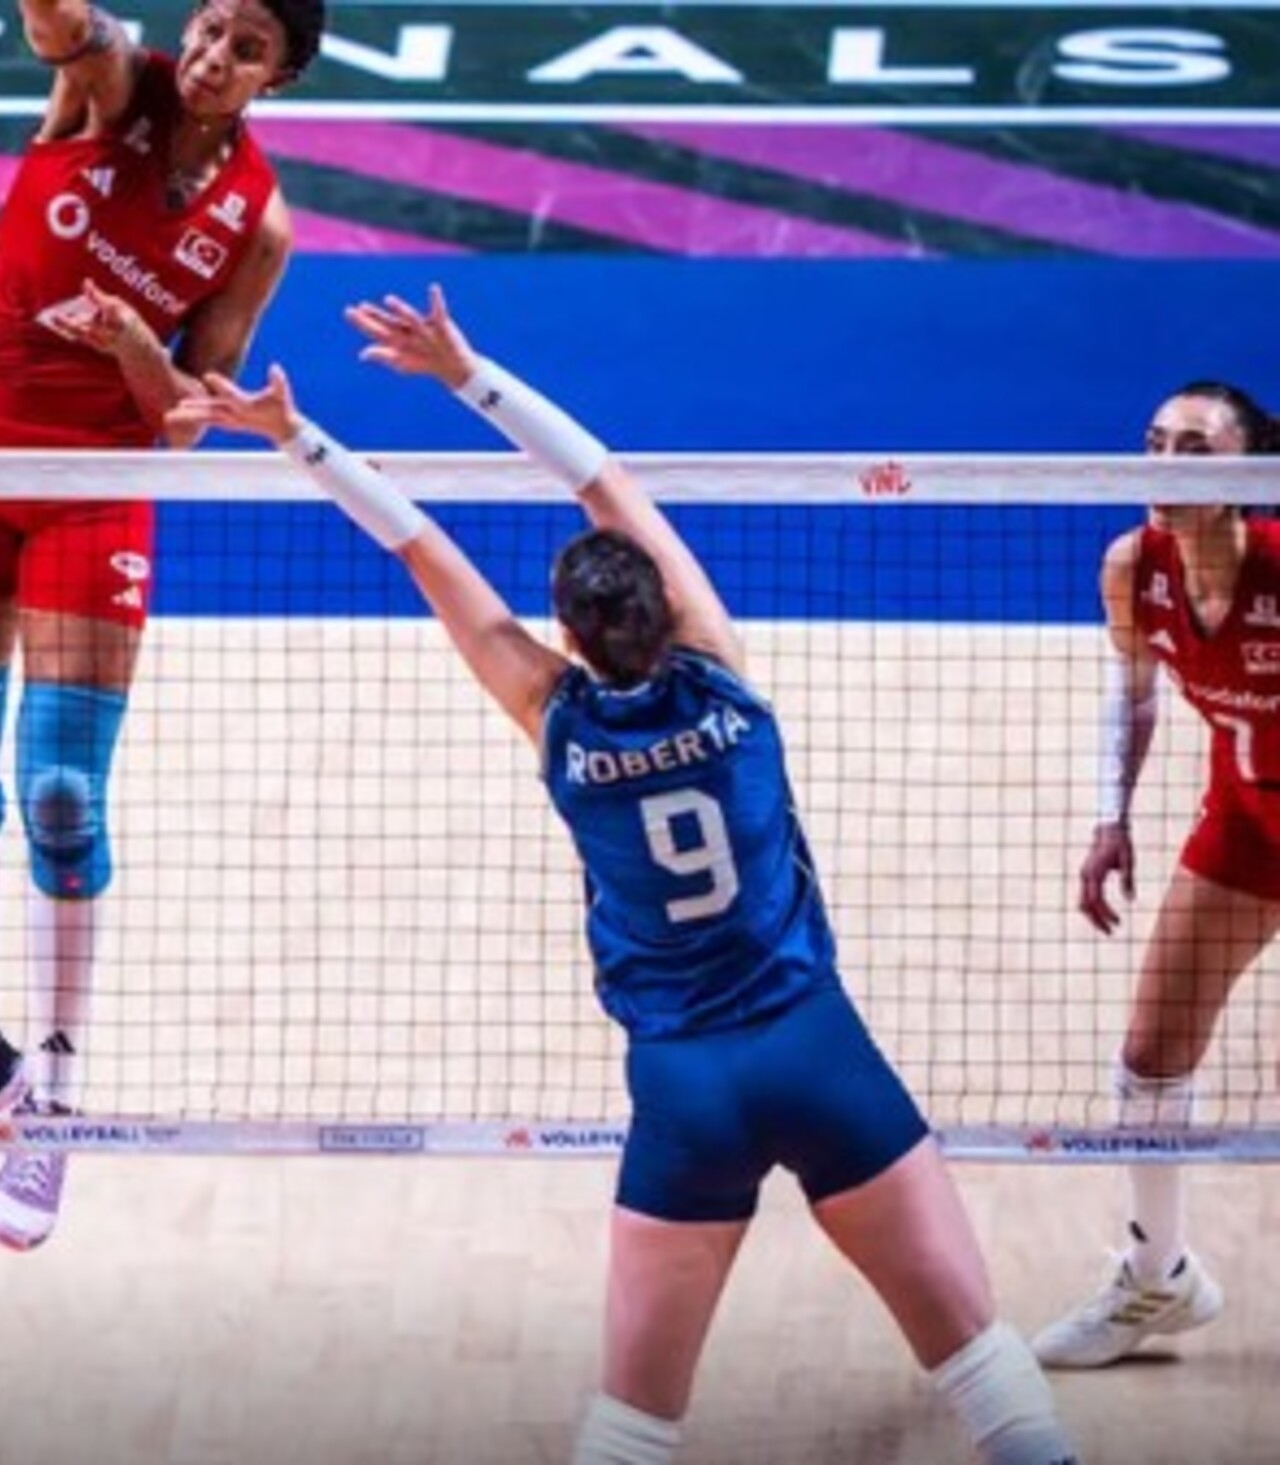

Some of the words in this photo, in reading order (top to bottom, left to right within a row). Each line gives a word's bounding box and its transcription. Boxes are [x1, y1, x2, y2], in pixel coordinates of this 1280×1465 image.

[566, 704, 752, 785] ROBERTA
[639, 787, 740, 923] 9
[22, 1124, 139, 1142] VOLLEYBALL
